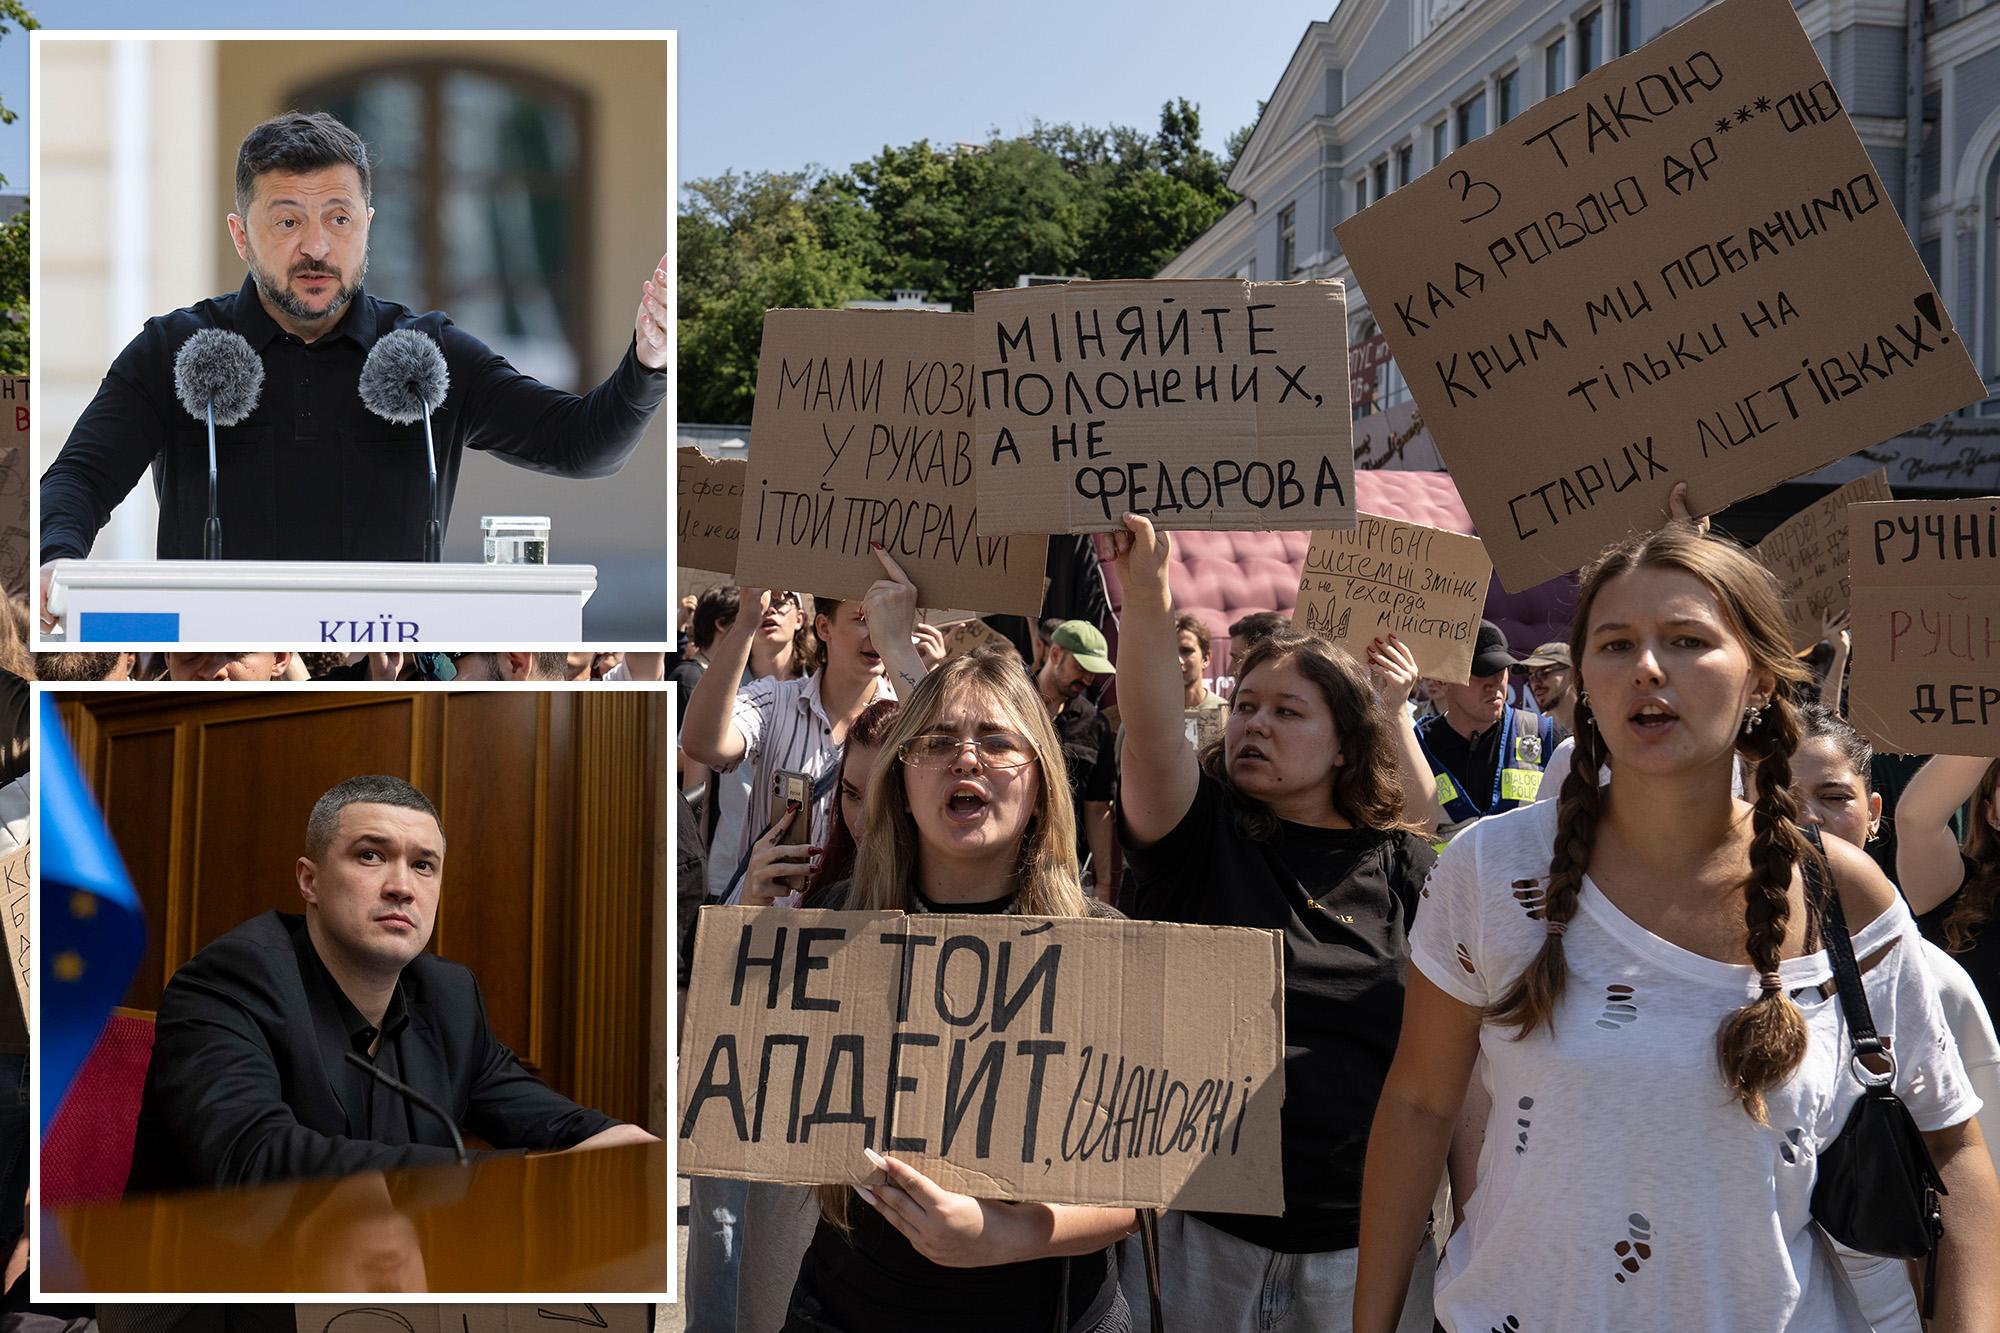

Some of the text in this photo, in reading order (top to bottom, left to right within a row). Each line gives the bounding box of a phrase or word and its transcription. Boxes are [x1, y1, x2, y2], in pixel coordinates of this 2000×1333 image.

[1447, 50, 1724, 224] З ТАКОЮ
[1393, 175, 1649, 337] КАДРОВОЮ
[1434, 172, 1880, 408] КРИМ МИ ПОБАЧИМО
[1740, 290, 1801, 338] НА
[996, 297, 1278, 364] МІНЯЙТЕ
[776, 356, 884, 415] МАЛИ
[822, 422, 856, 478] У
[991, 420, 1113, 466] А НЕ
[1074, 455, 1346, 521] ФЕДОРОВА
[1507, 436, 1669, 541] СТАРИХ
[1874, 505, 1998, 566] РУЧНІ
[319, 614, 420, 642] КИЇВ
[1908, 683, 2000, 726] ДЕР
[729, 920, 1063, 1035] НЕ ТОЙ
[679, 1020, 1067, 1174] АПДЕЙТ,
